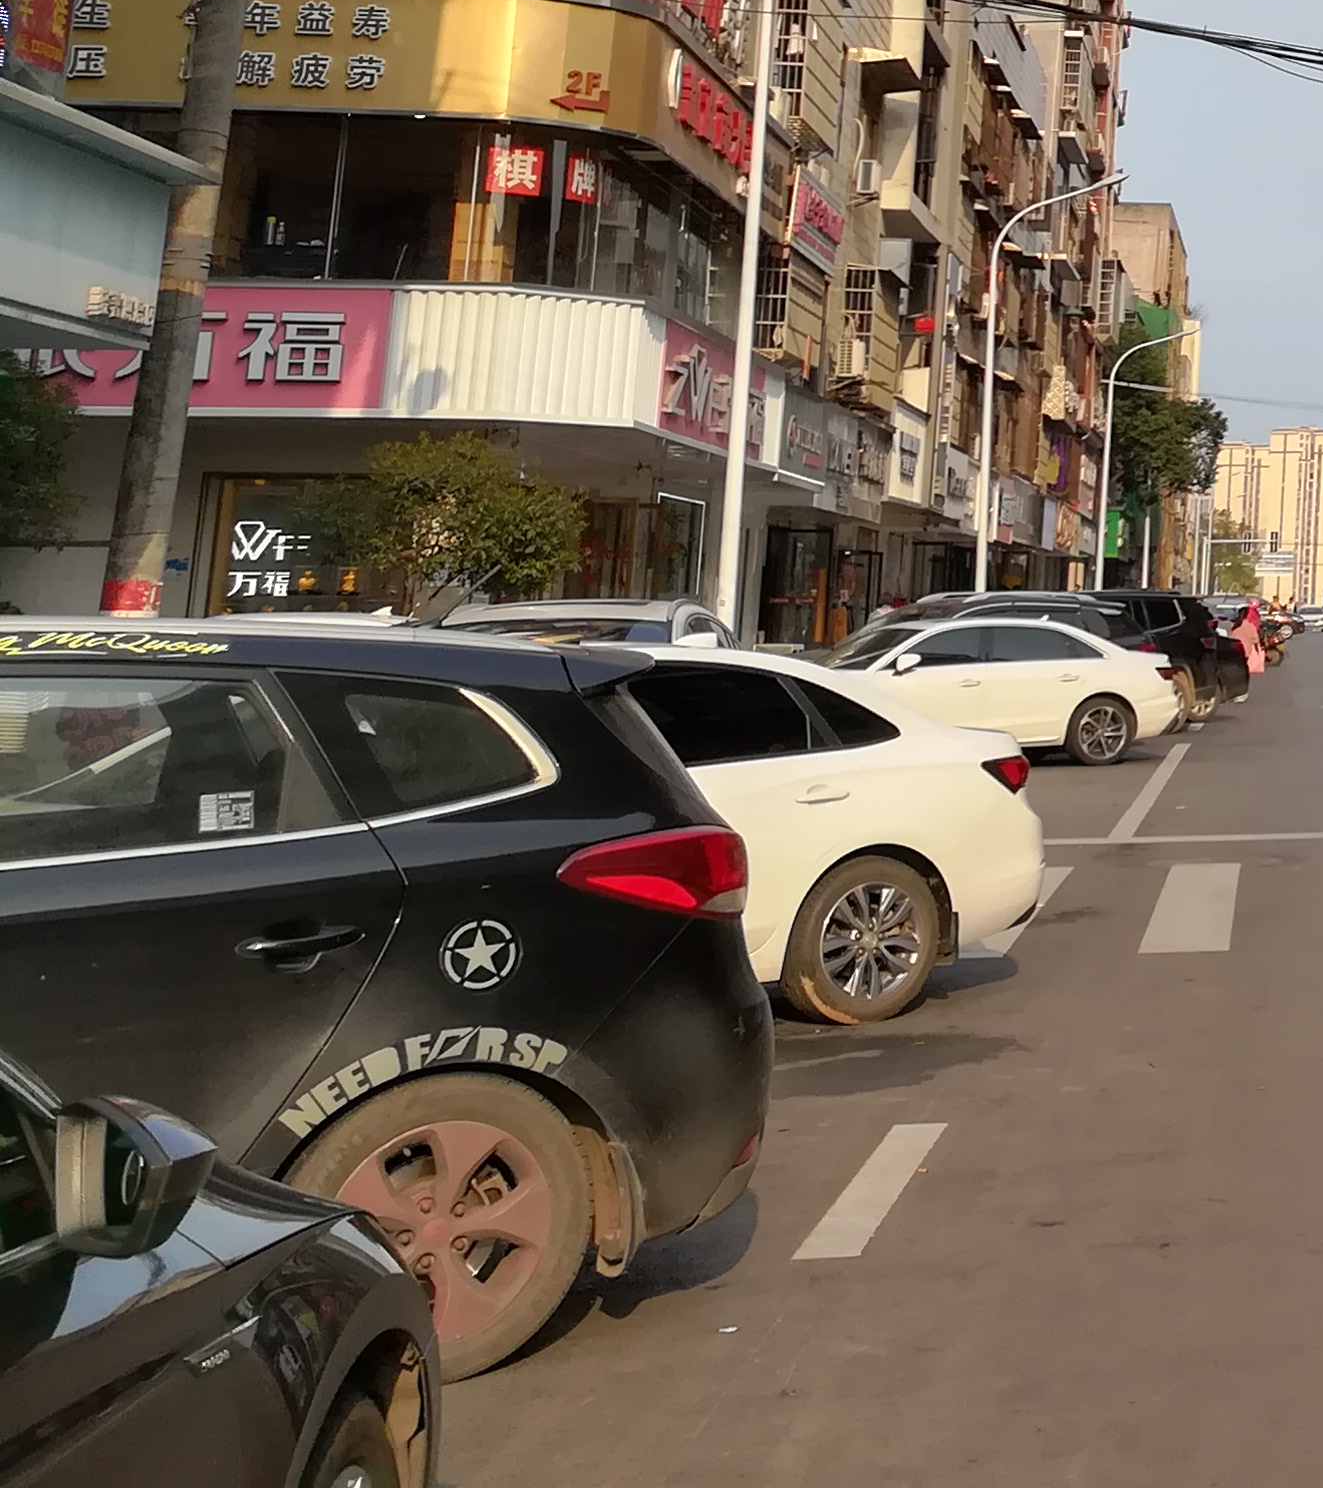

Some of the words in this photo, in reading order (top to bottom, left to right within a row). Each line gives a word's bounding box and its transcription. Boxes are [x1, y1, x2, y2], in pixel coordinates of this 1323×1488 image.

[179, 50, 387, 90] 解疲劳
[566, 69, 603, 95] 2F
[227, 571, 291, 597] 万福
[278, 1045, 402, 1140] NEED
